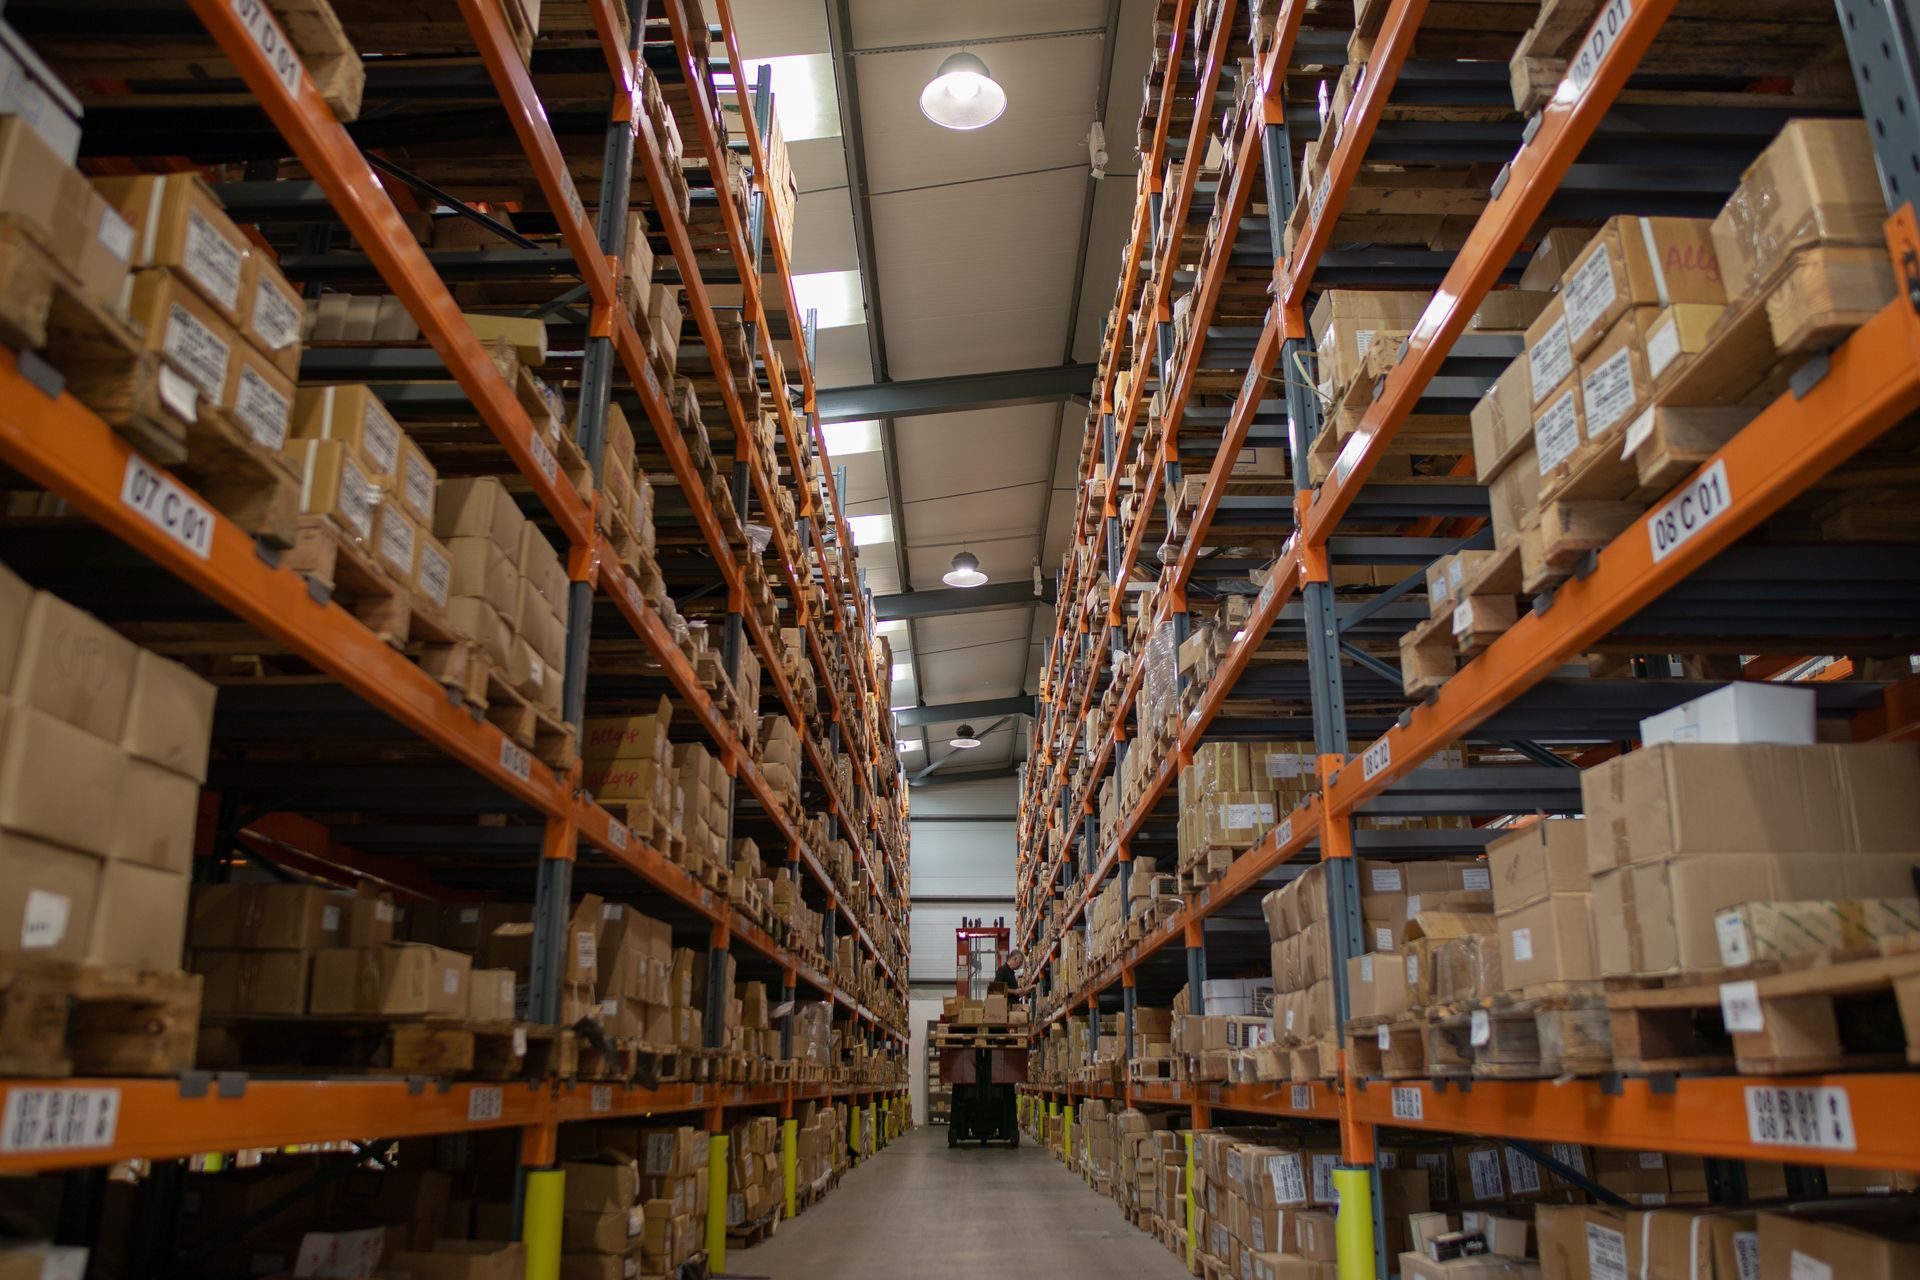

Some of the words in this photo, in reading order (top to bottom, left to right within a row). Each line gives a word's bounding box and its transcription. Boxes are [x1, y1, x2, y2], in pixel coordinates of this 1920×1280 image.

[1573, 51, 1591, 91] 08
[1592, 29, 1605, 62] D
[1607, 0, 1626, 36] 01
[277, 47, 297, 88] 01
[131, 468, 161, 511] 07
[162, 493, 182, 527] C
[182, 508, 207, 548] 01
[1655, 511, 1677, 551] 08
[1680, 495, 1695, 530] C
[1698, 472, 1722, 516] 01
[1365, 754, 1373, 776] 08
[1379, 742, 1388, 765] 02
[1753, 1089, 1775, 1114] 08
[1778, 1090, 1791, 1114] B
[1795, 1090, 1817, 1115] 01
[1757, 1115, 1779, 1140] 08
[1783, 1116, 1797, 1140] A
[1799, 1116, 1822, 1142] 01
